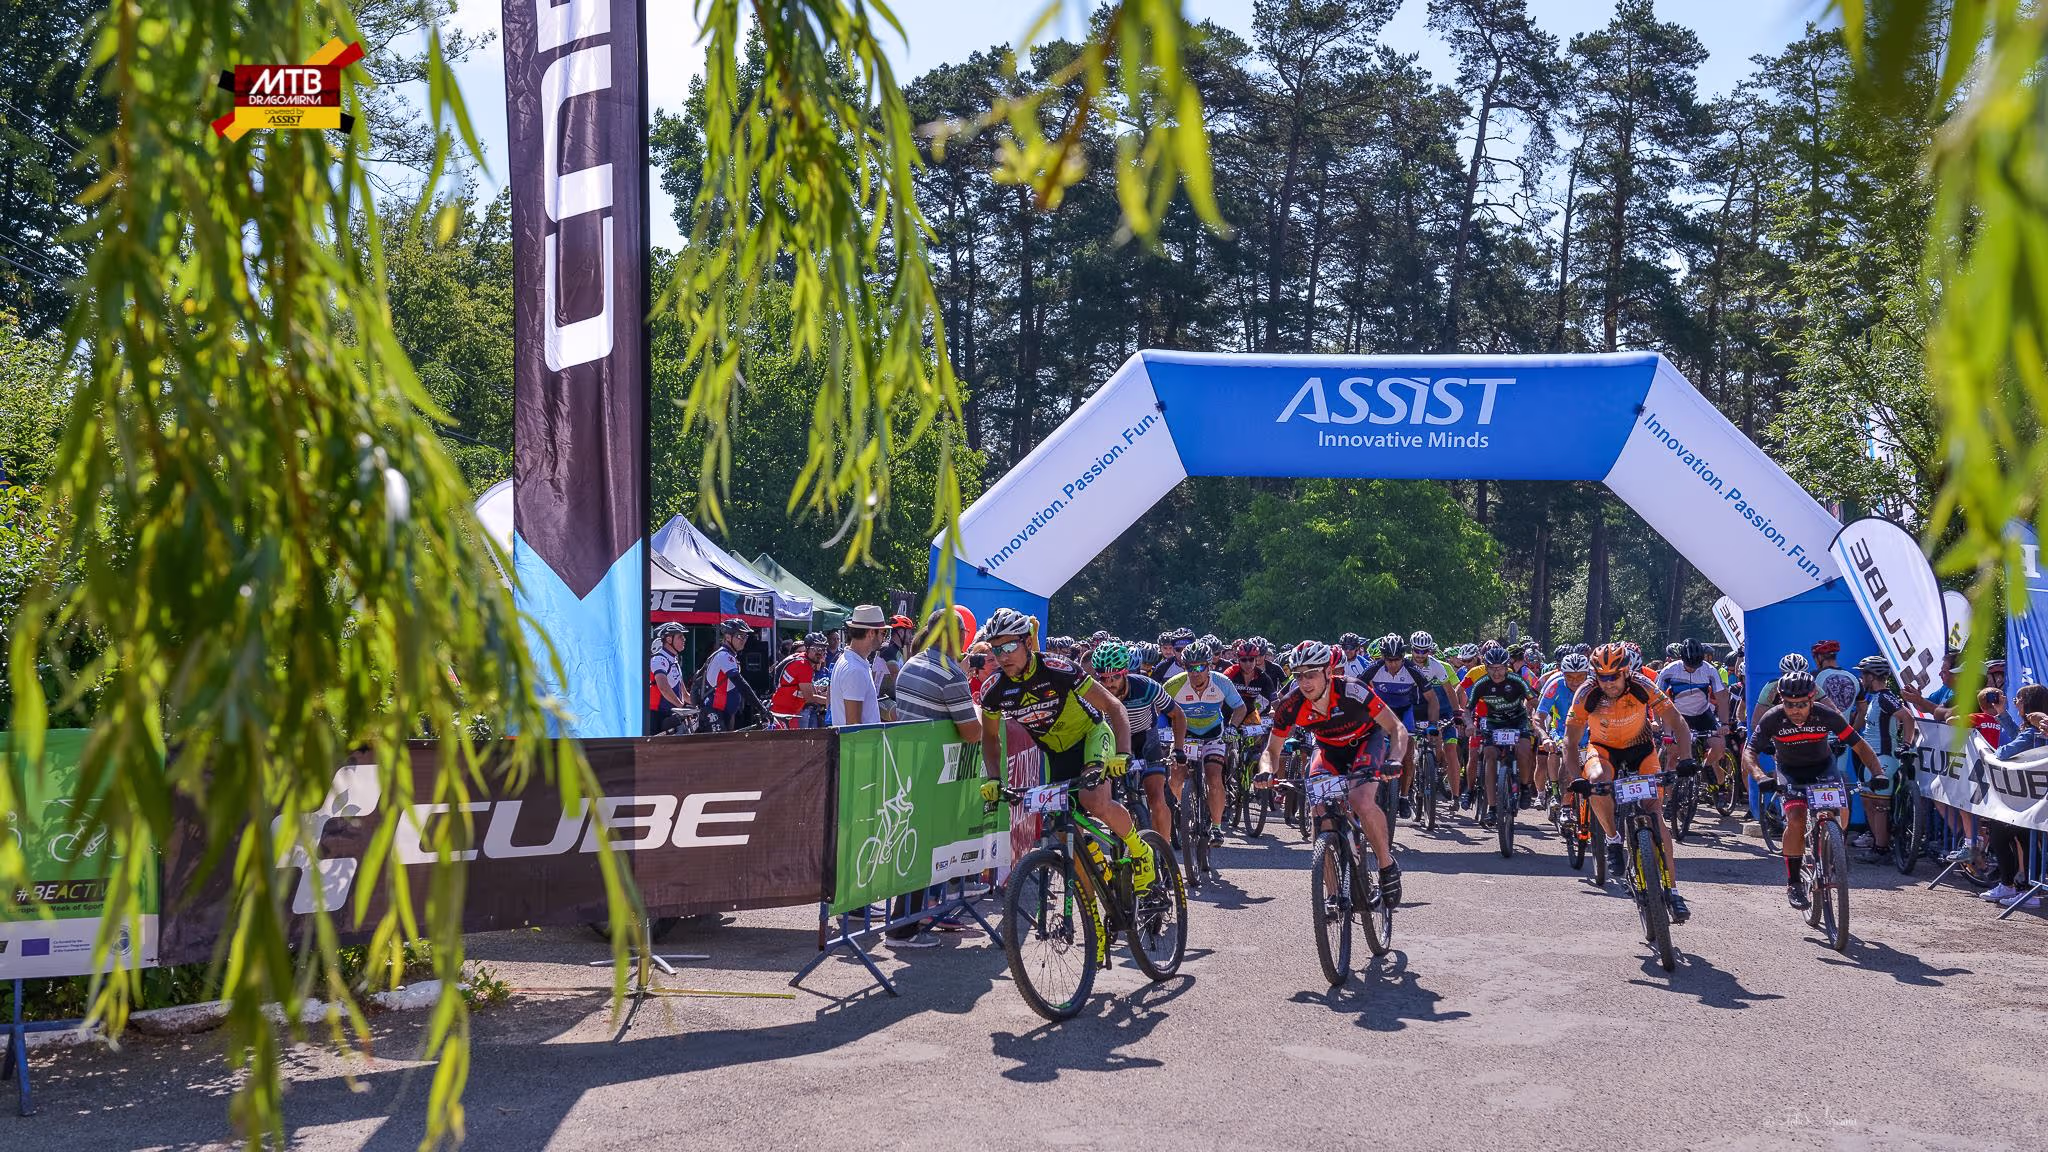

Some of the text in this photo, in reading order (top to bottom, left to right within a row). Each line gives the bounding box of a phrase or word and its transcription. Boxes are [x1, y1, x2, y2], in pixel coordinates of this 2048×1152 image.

[1276, 377, 1517, 425] ASSIST
[1318, 430, 1489, 448] Innovative Minds
[984, 412, 1159, 570] Innovation. Passion. Fun.
[1643, 413, 1820, 581] Innovation. Passion. Fun.
[743, 595, 770, 617] CUBE
[1918, 746, 1967, 781] CUE
[1628, 785, 1642, 795] 55
[1988, 763, 2048, 801] CUB
[1039, 790, 1053, 804] 64
[1820, 792, 1834, 802] 46
[391, 791, 763, 865] CUBE
[16, 882, 110, 901] #BEACTIV
